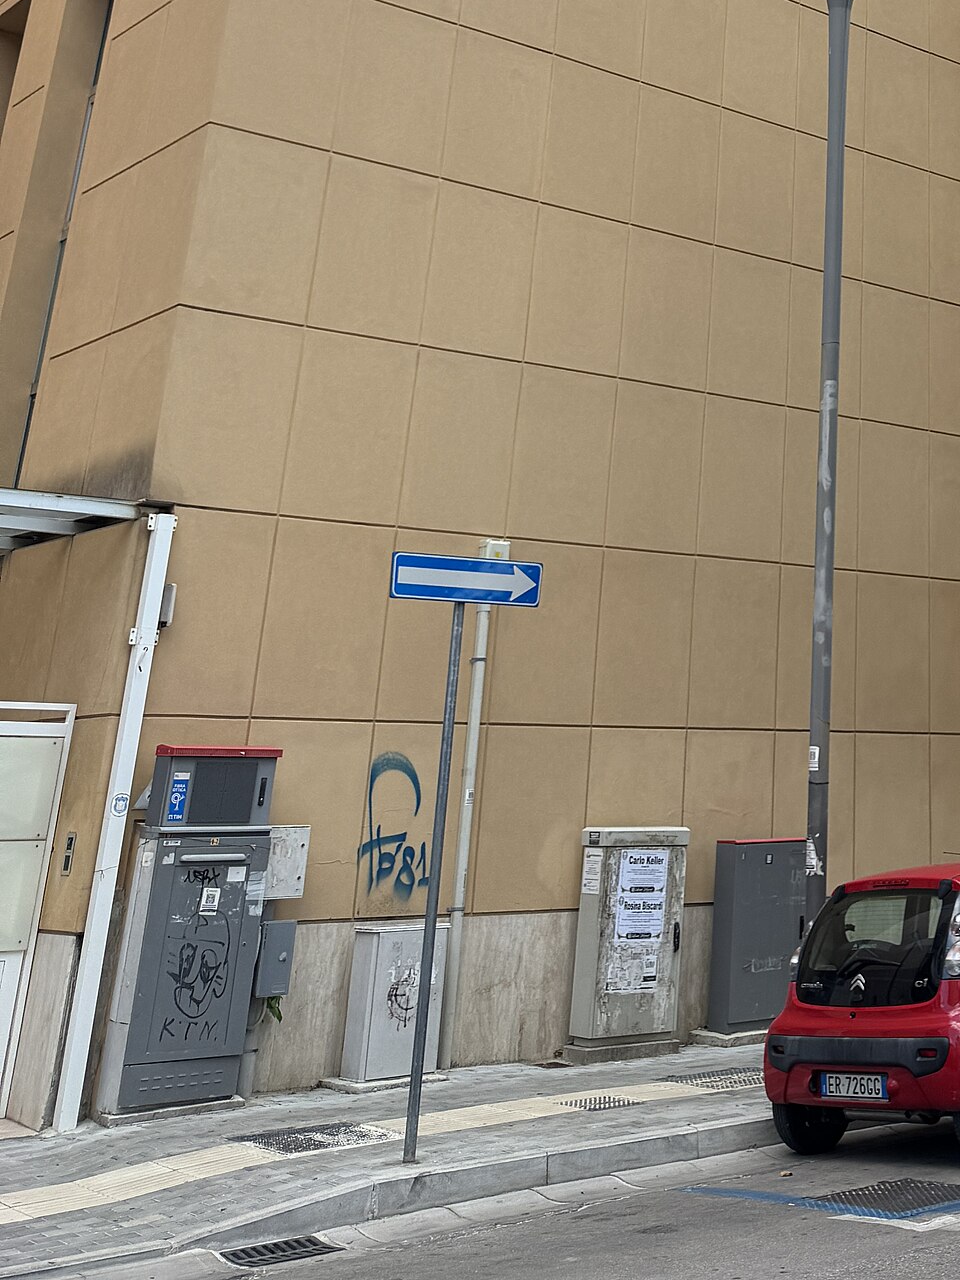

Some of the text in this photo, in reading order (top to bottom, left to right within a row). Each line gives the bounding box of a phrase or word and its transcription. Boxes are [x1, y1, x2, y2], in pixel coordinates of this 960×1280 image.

[629, 855, 665, 865] Carlo Keller
[624, 900, 663, 910] Rosina Biscardi
[828, 1075, 881, 1095] ER 726GG
